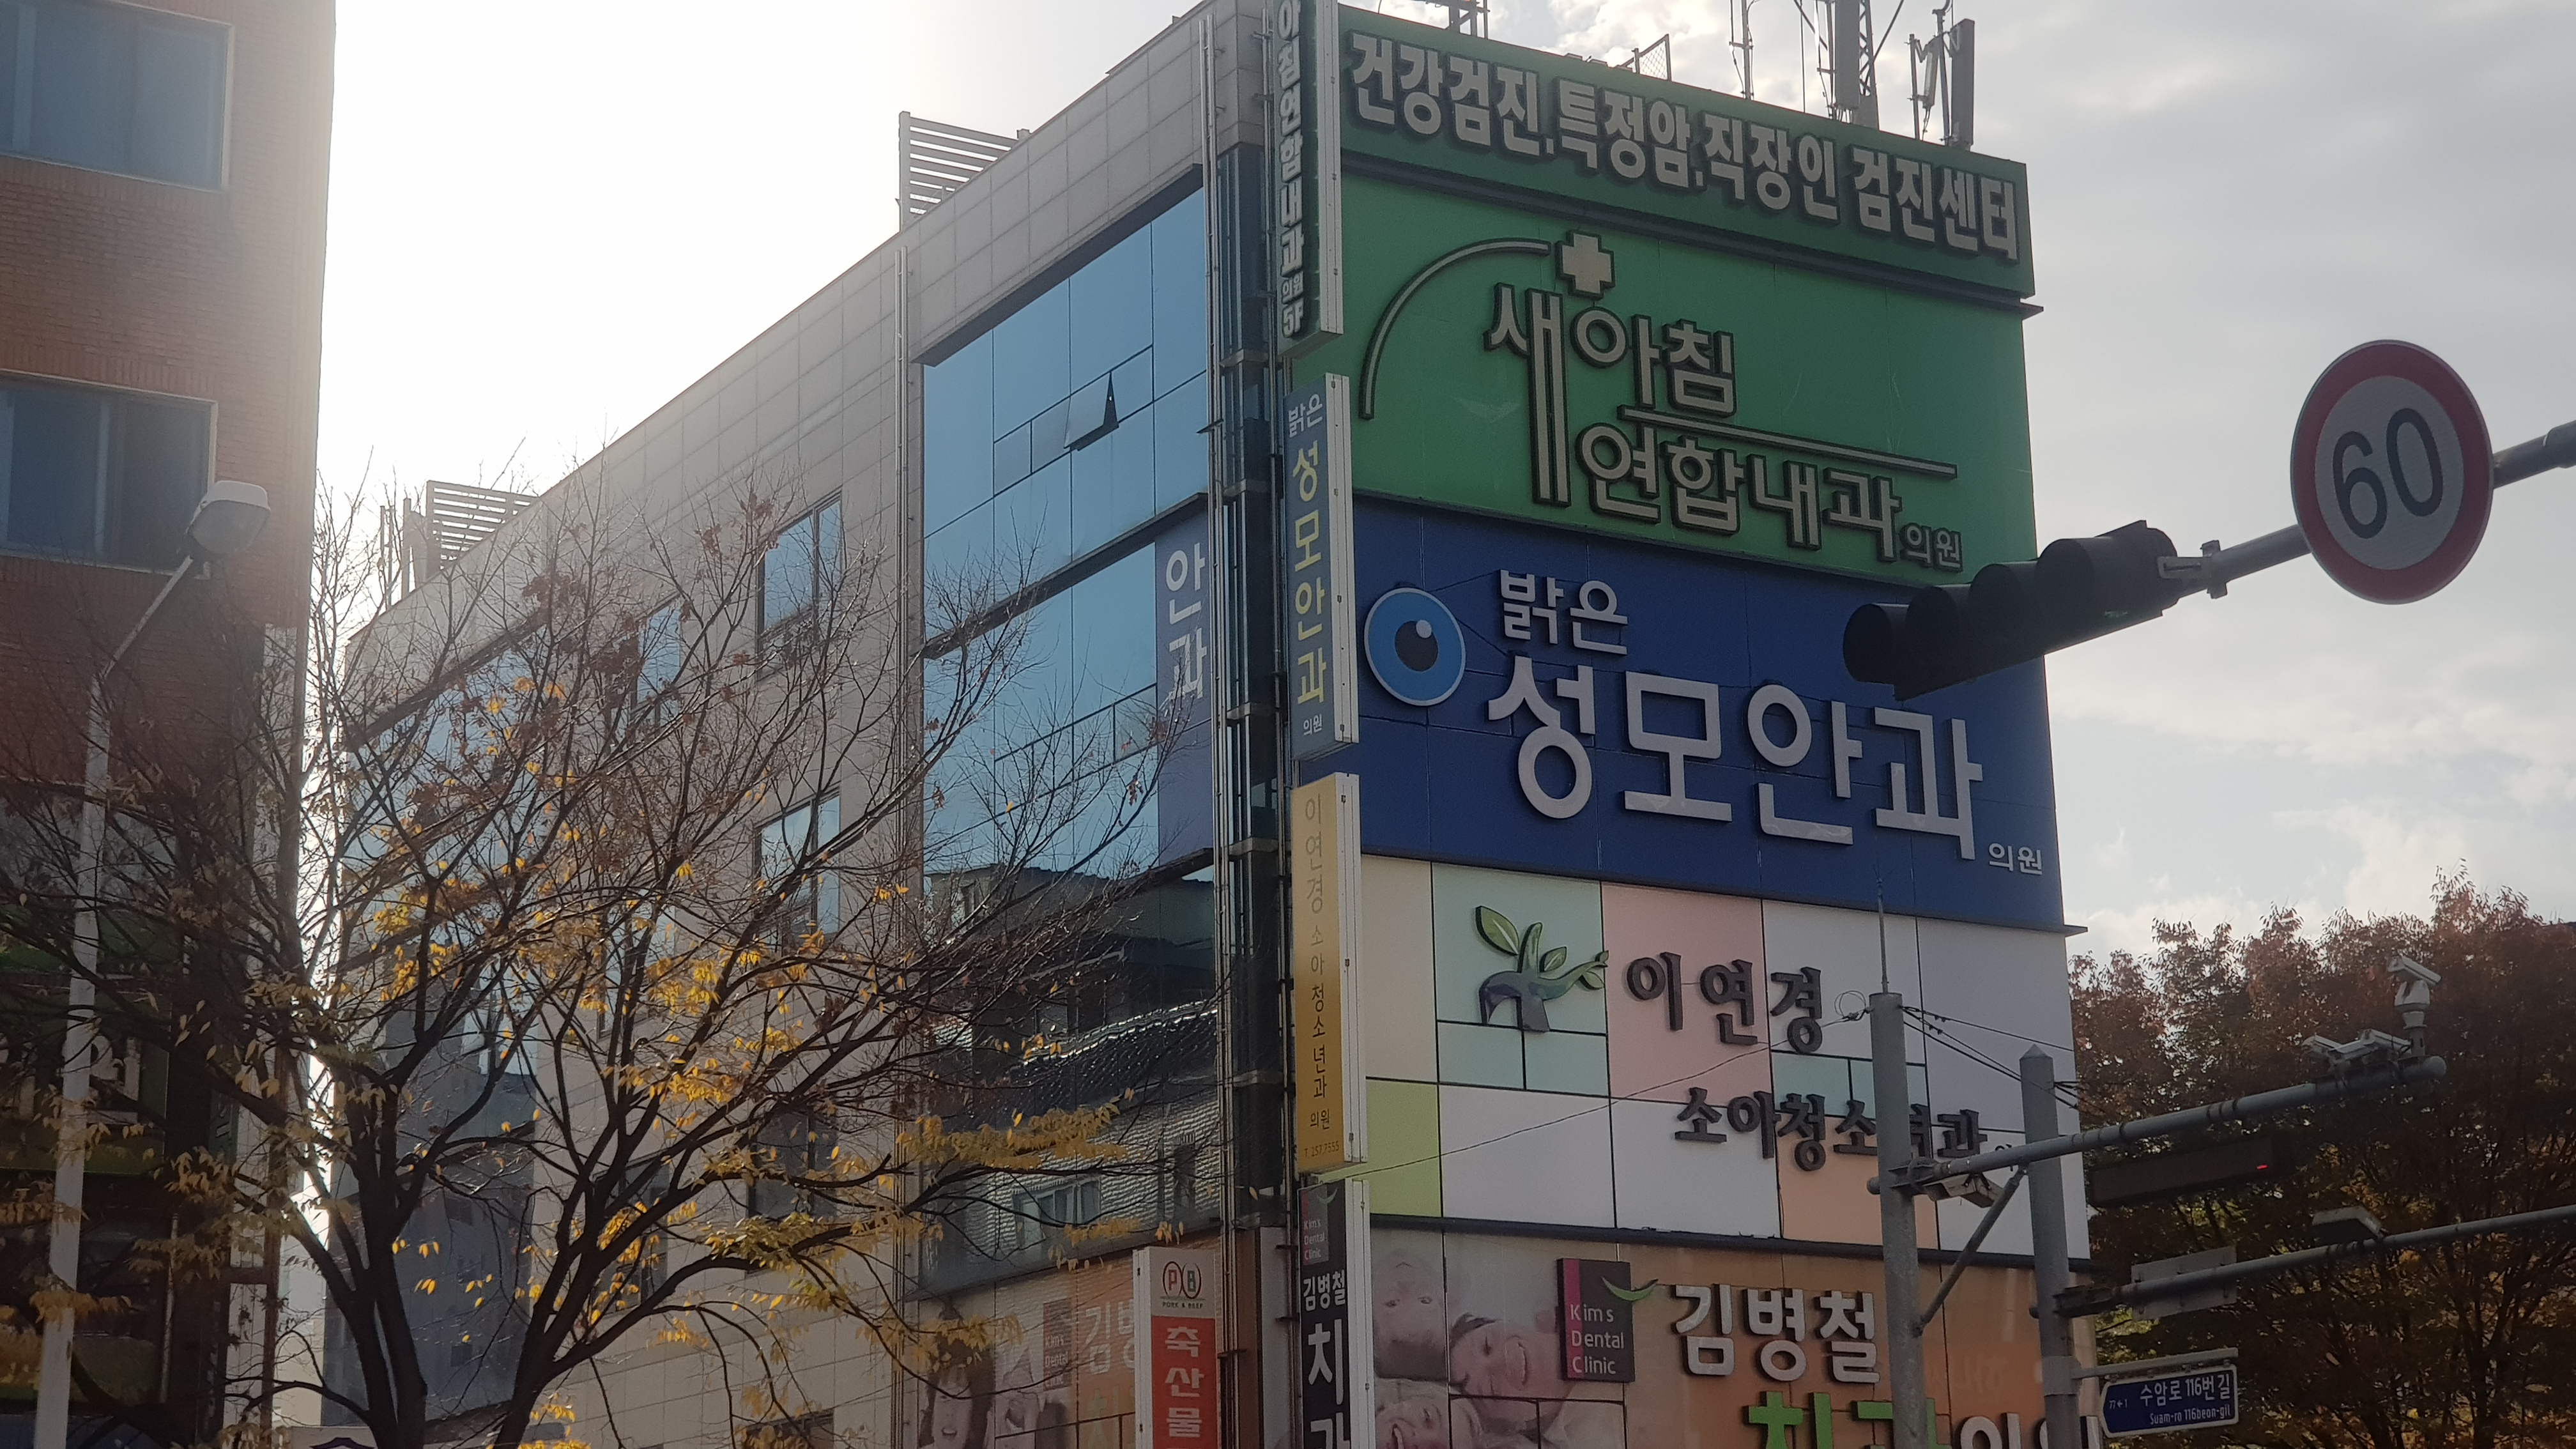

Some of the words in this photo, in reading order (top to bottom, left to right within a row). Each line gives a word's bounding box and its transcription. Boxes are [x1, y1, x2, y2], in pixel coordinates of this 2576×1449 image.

[1853, 146, 2018, 261] 검진센터
[1283, 298, 1304, 336] 5F
[1287, 393, 1323, 438] 밝은
[1485, 283, 1736, 506] 새아침
[2332, 407, 2444, 539] 60
[1292, 440, 1327, 704] 성모안과
[1165, 542, 1208, 702] 안과
[1499, 569, 1629, 656] 밝은
[1303, 713, 1322, 737] 의원
[1488, 656, 1983, 861] 성모안과
[1988, 841, 2043, 876] 의원
[1309, 923, 1327, 1100] 소아청소년과
[1626, 951, 1823, 1054] 이연경
[1310, 1108, 1330, 1130] 의원
[1304, 1231, 1325, 1245] Dental
[1305, 1248, 1322, 1260] Clinic
[1303, 1269, 1346, 1312] 김병철
[1571, 1330, 1625, 1349] Dental
[1671, 1283, 1882, 1384] 김병철
[1572, 1356, 1616, 1375] Clinic
[2140, 1380, 2182, 1406] 수암로
[2185, 1373, 2231, 1401] 116번길
[2150, 1413, 2182, 1425] Suam-ro
[2184, 1404, 2231, 1422] 116beon-gil
